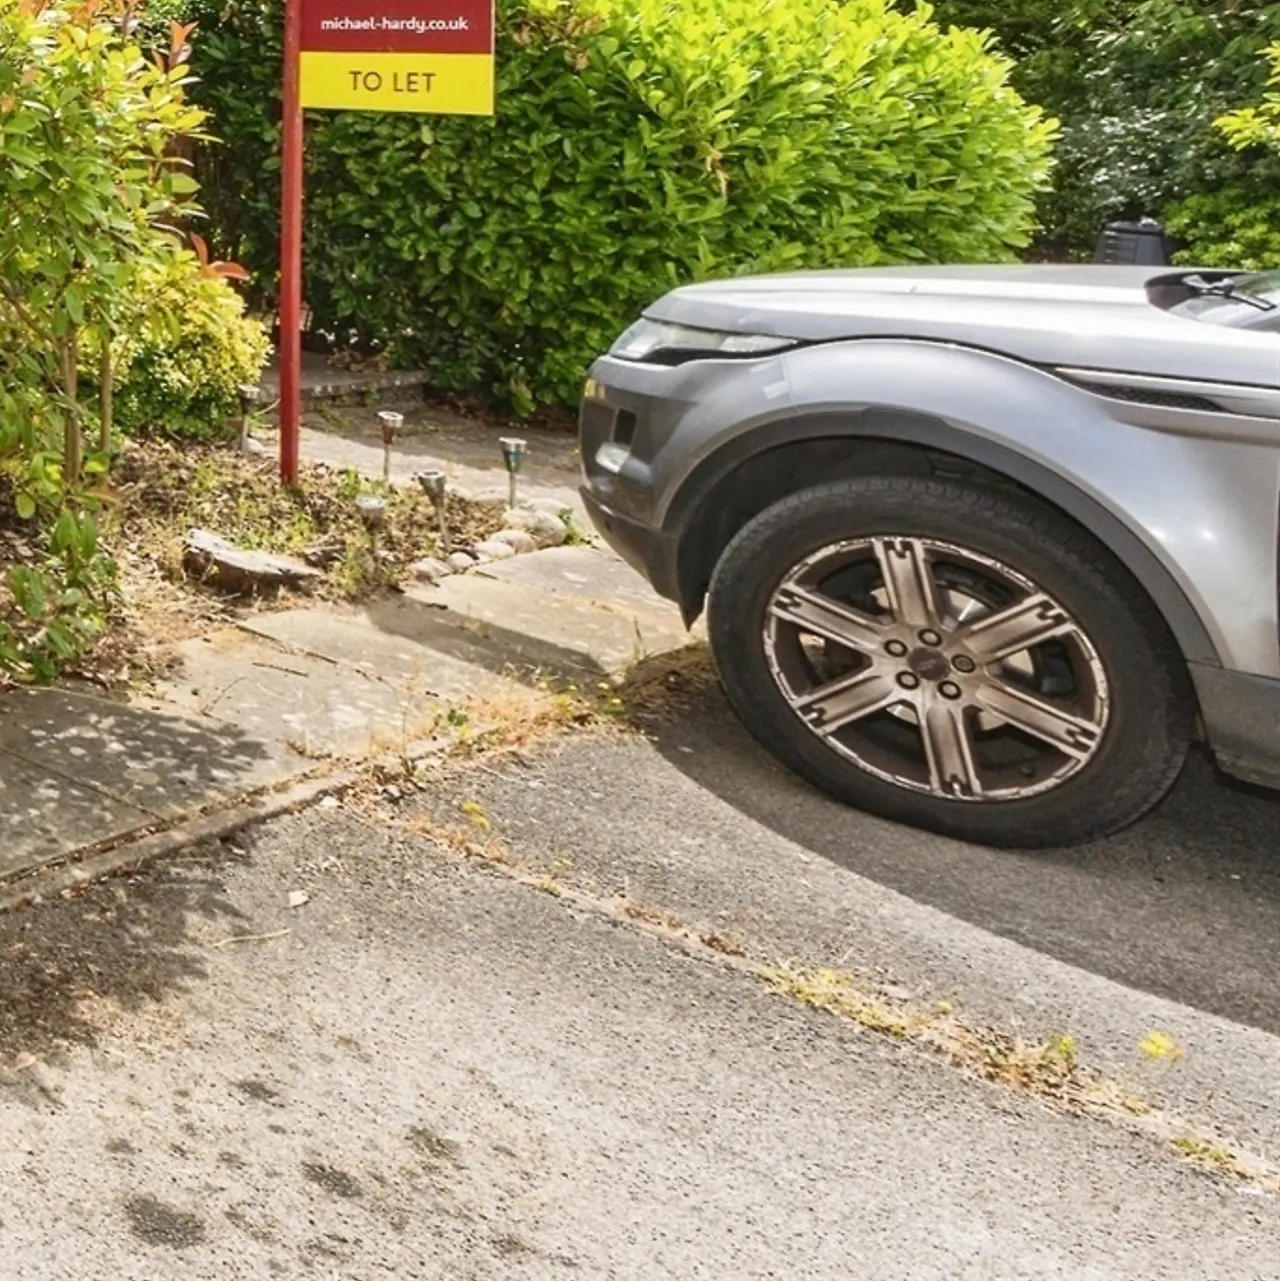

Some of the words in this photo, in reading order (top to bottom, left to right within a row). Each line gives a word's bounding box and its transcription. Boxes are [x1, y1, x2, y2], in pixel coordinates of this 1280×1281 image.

[321, 16, 469, 34] michael-hardy.co.uk
[349, 70, 383, 92] TO
[393, 72, 436, 93] LET
